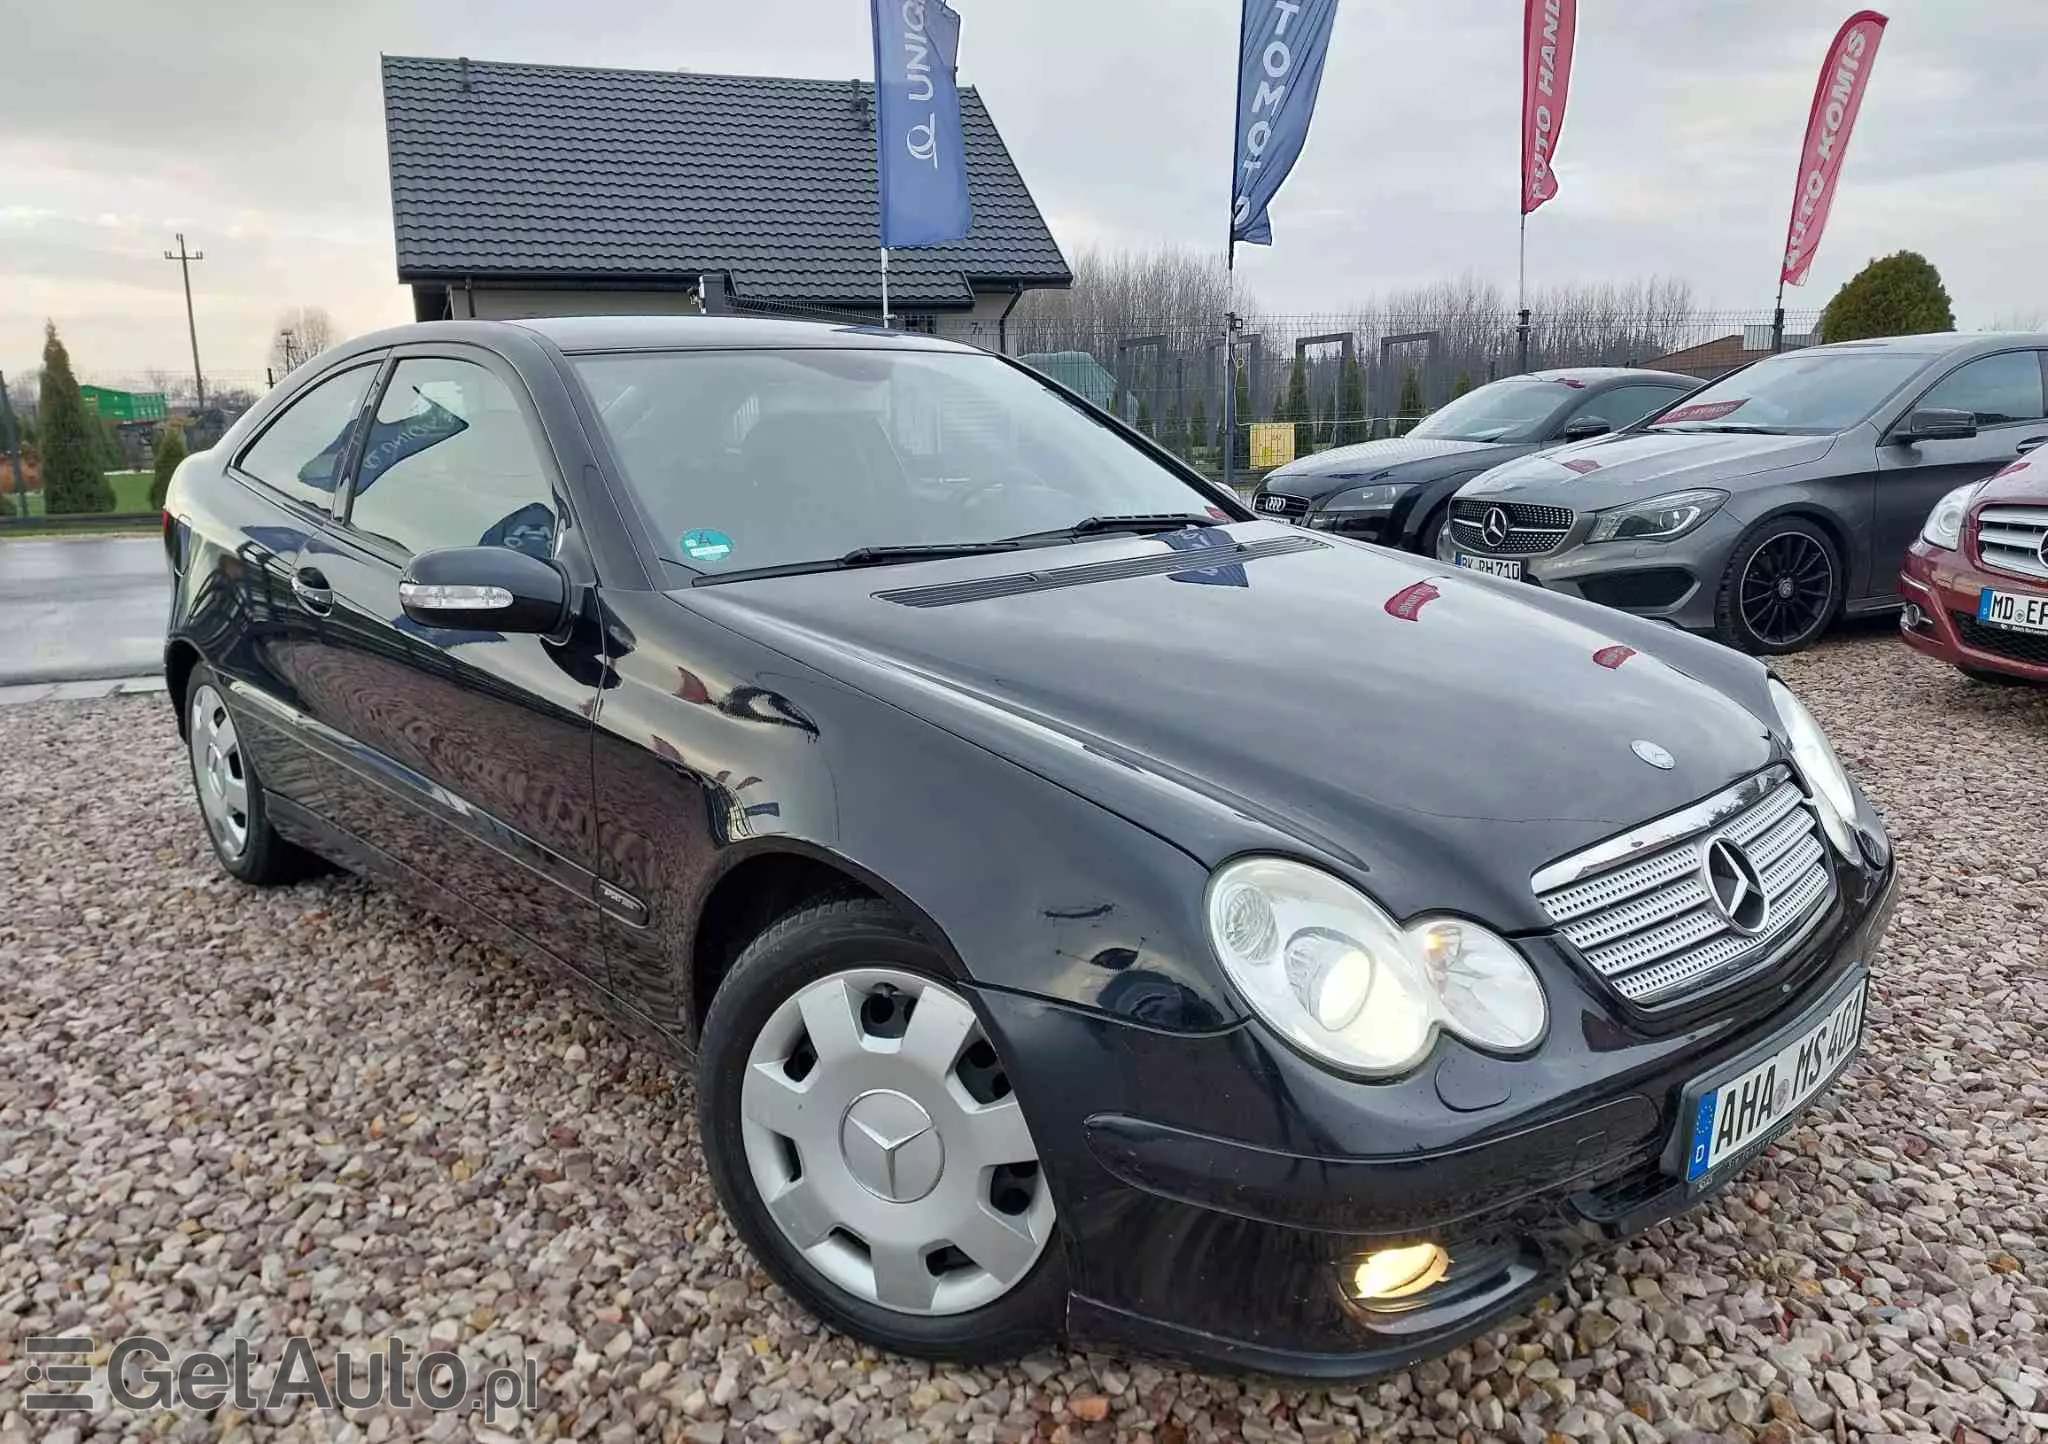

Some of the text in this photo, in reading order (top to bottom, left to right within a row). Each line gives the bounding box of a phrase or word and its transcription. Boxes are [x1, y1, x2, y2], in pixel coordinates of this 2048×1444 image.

[1817, 29, 1866, 162] KOMIS
[1495, 561, 1520, 580] 710
[1991, 593, 2014, 621] MD
[1714, 1063, 1777, 1155] AHA
[1791, 1026, 1827, 1101] MS
[1695, 1144, 1704, 1163] D
